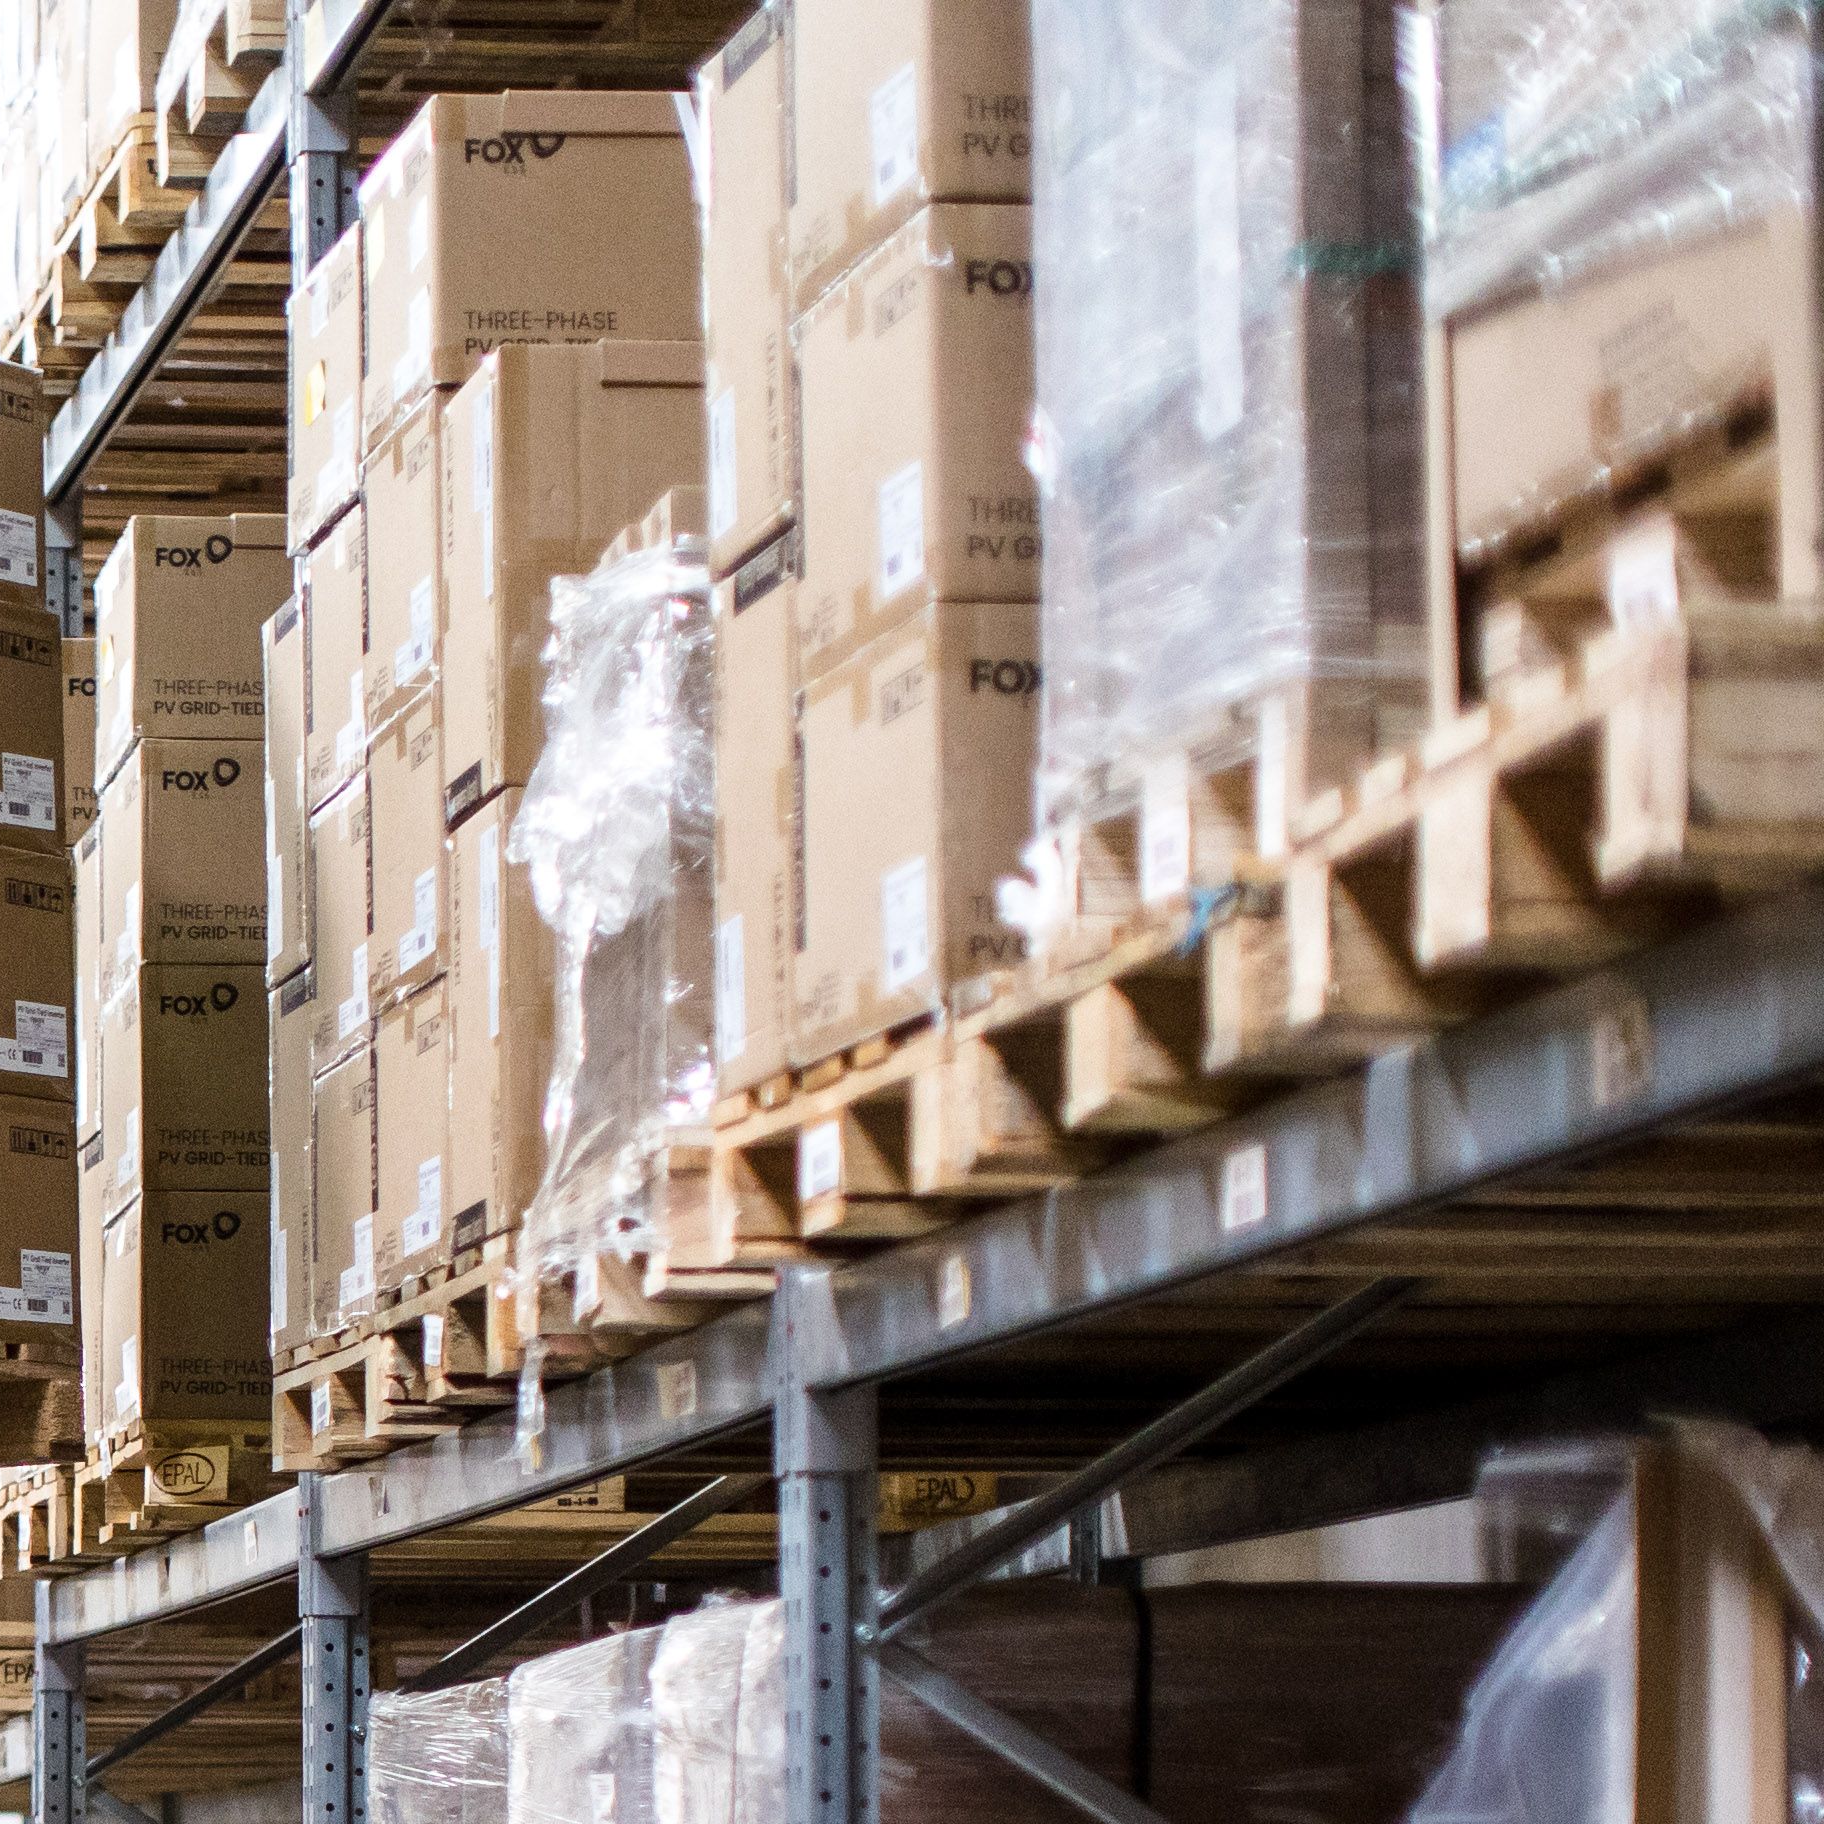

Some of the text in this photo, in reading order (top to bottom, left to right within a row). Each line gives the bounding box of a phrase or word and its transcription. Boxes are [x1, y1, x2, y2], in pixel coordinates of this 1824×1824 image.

[464, 136, 524, 166] FOX
[963, 133, 1001, 157] PV
[464, 310, 618, 332] THREE-PHASE
[155, 546, 203, 568] FOX
[968, 535, 1007, 559] PV
[153, 679, 264, 696] THREE-PHAS
[154, 701, 265, 716] PV GRID-TIED
[163, 770, 209, 791] FOX
[159, 903, 268, 921] THREE-PHAS
[161, 925, 184, 941] PV
[159, 995, 208, 1017] FOX
[159, 1129, 270, 1146] THREE-PHAS
[158, 1150, 181, 1166] PV
[162, 1223, 211, 1245] FOX
[161, 1359, 272, 1376] THREE-PHAS
[160, 1380, 181, 1395] PV
[163, 1462, 205, 1486] EPAL
